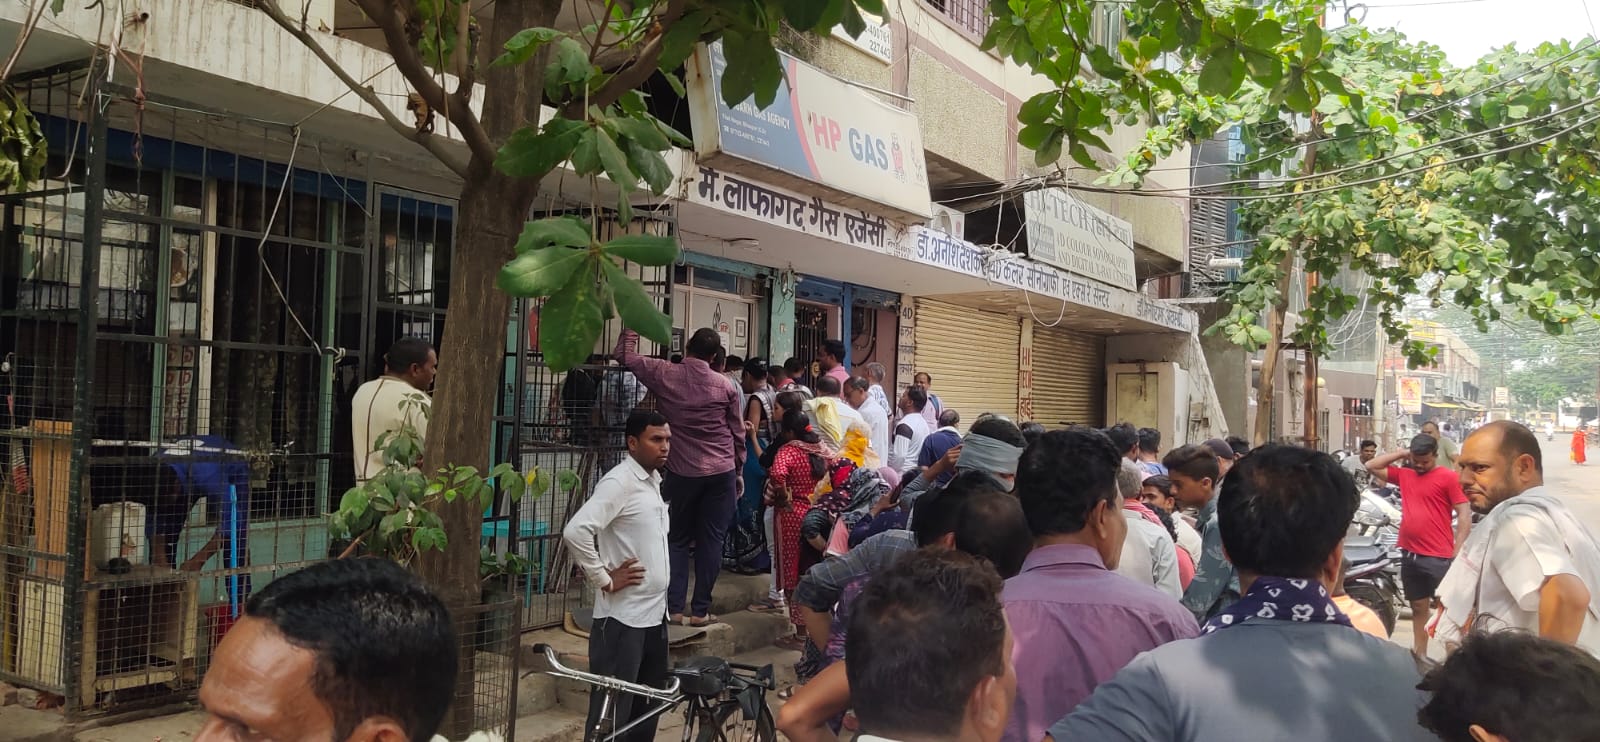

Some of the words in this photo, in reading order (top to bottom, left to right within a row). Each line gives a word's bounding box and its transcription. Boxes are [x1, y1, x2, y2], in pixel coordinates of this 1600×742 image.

[767, 111, 790, 130] AGENCY
[811, 111, 842, 152] HP
[848, 127, 889, 171] GAS
[809, 196, 841, 237] गैस
[844, 210, 887, 248] एजेंसी
[1071, 254, 1094, 274] DIGITAL
[902, 307, 913, 320] 4D
